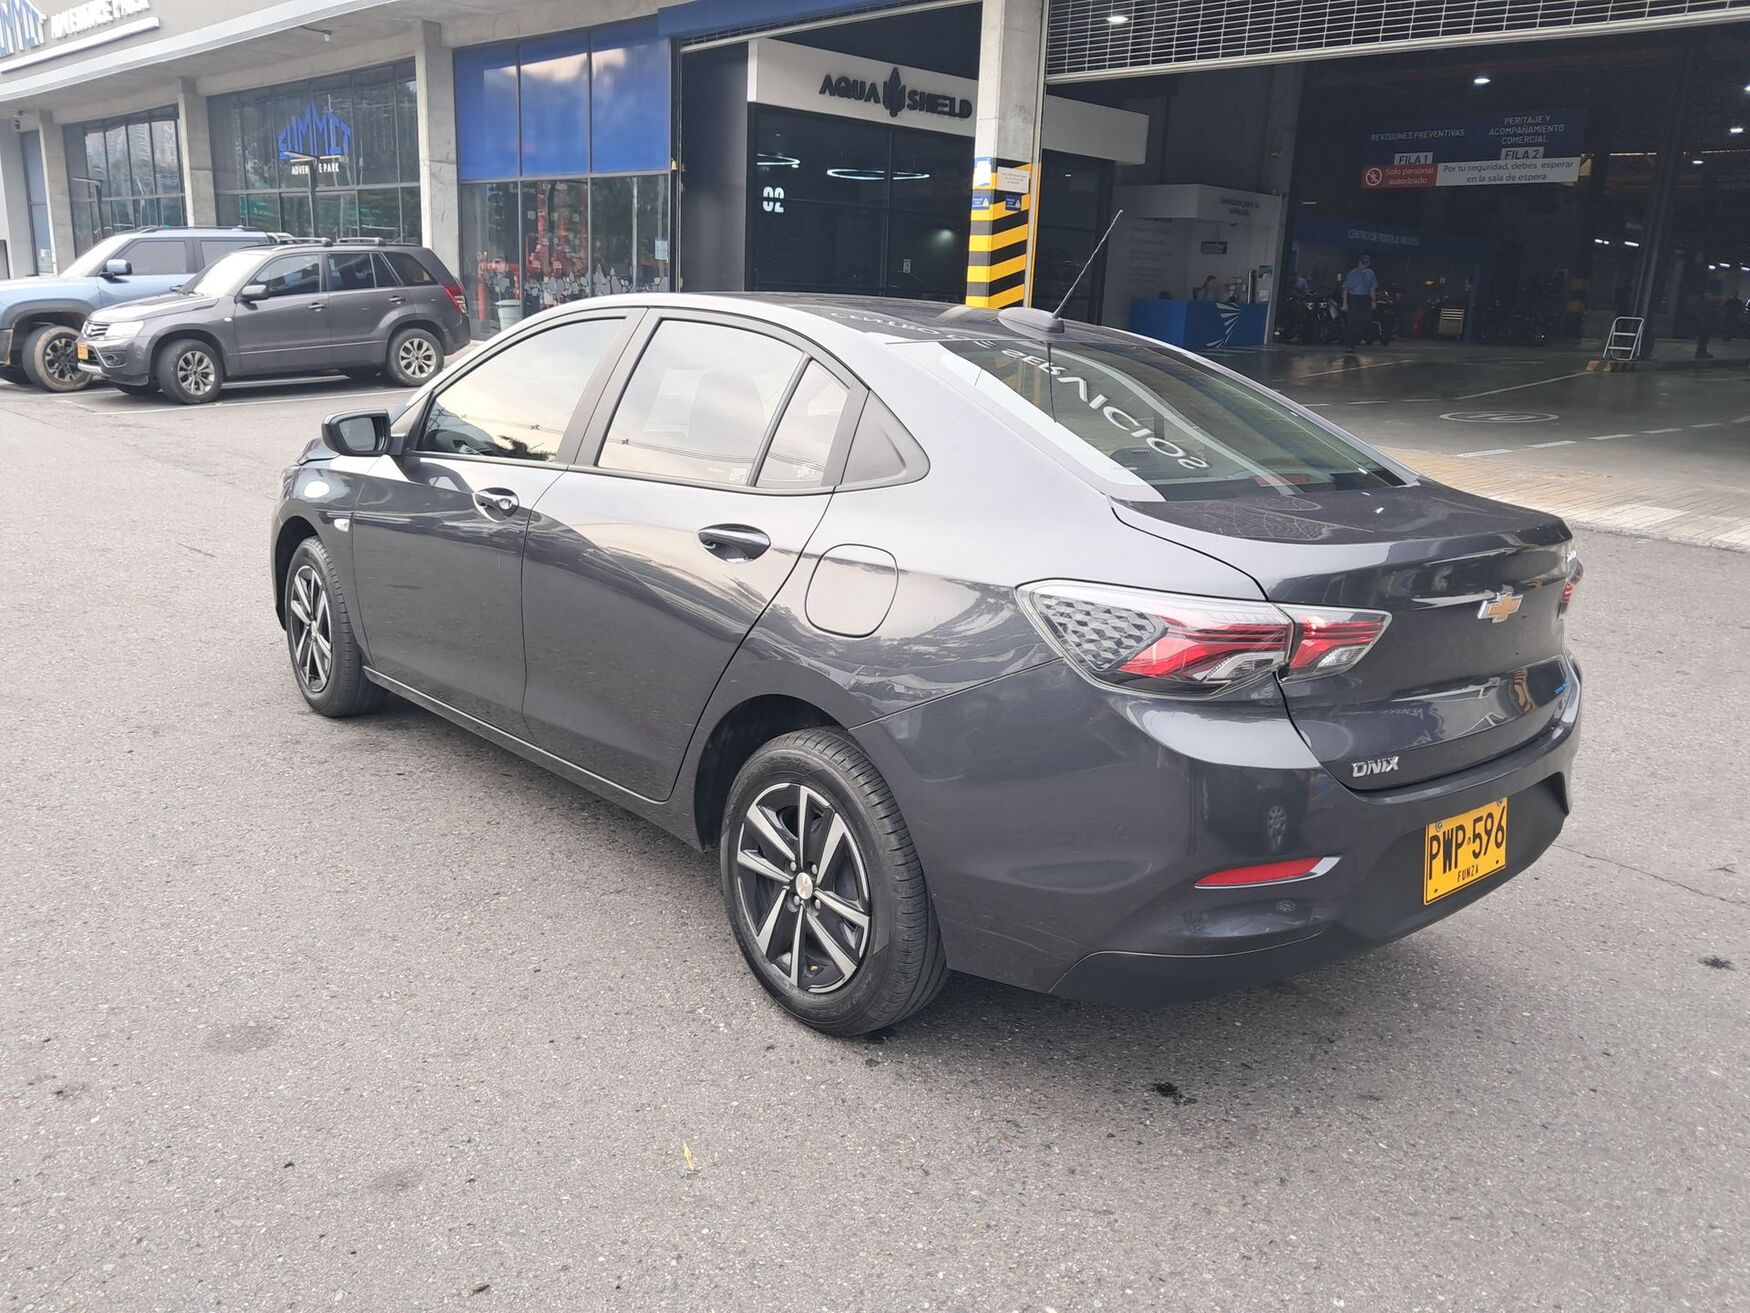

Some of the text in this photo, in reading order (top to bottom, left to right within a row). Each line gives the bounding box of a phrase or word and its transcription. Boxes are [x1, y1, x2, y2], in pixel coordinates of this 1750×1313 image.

[819, 74, 973, 118] AQUA SHIELD
[1504, 115, 1551, 125] PERITAJE Y
[1370, 128, 1466, 142] REVISIONES PREVENTIVAS
[1489, 123, 1565, 136] ACOMPAÑAMIENTO
[1502, 135, 1548, 145] COMERCIAL
[1398, 154, 1421, 165] FILA
[1504, 149, 1540, 160] FILA 2
[1402, 166, 1435, 177] personal
[1443, 164, 1457, 173] Por
[1458, 164, 1466, 172] tu
[1511, 161, 1538, 170] debes
[1541, 160, 1575, 171] esperar
[1388, 176, 1428, 185] autorizado
[1466, 173, 1547, 183] en la sala de espera
[762, 186, 785, 214] 02
[1351, 755, 1400, 778] ONIX
[1457, 866, 1479, 883] FUNZA
